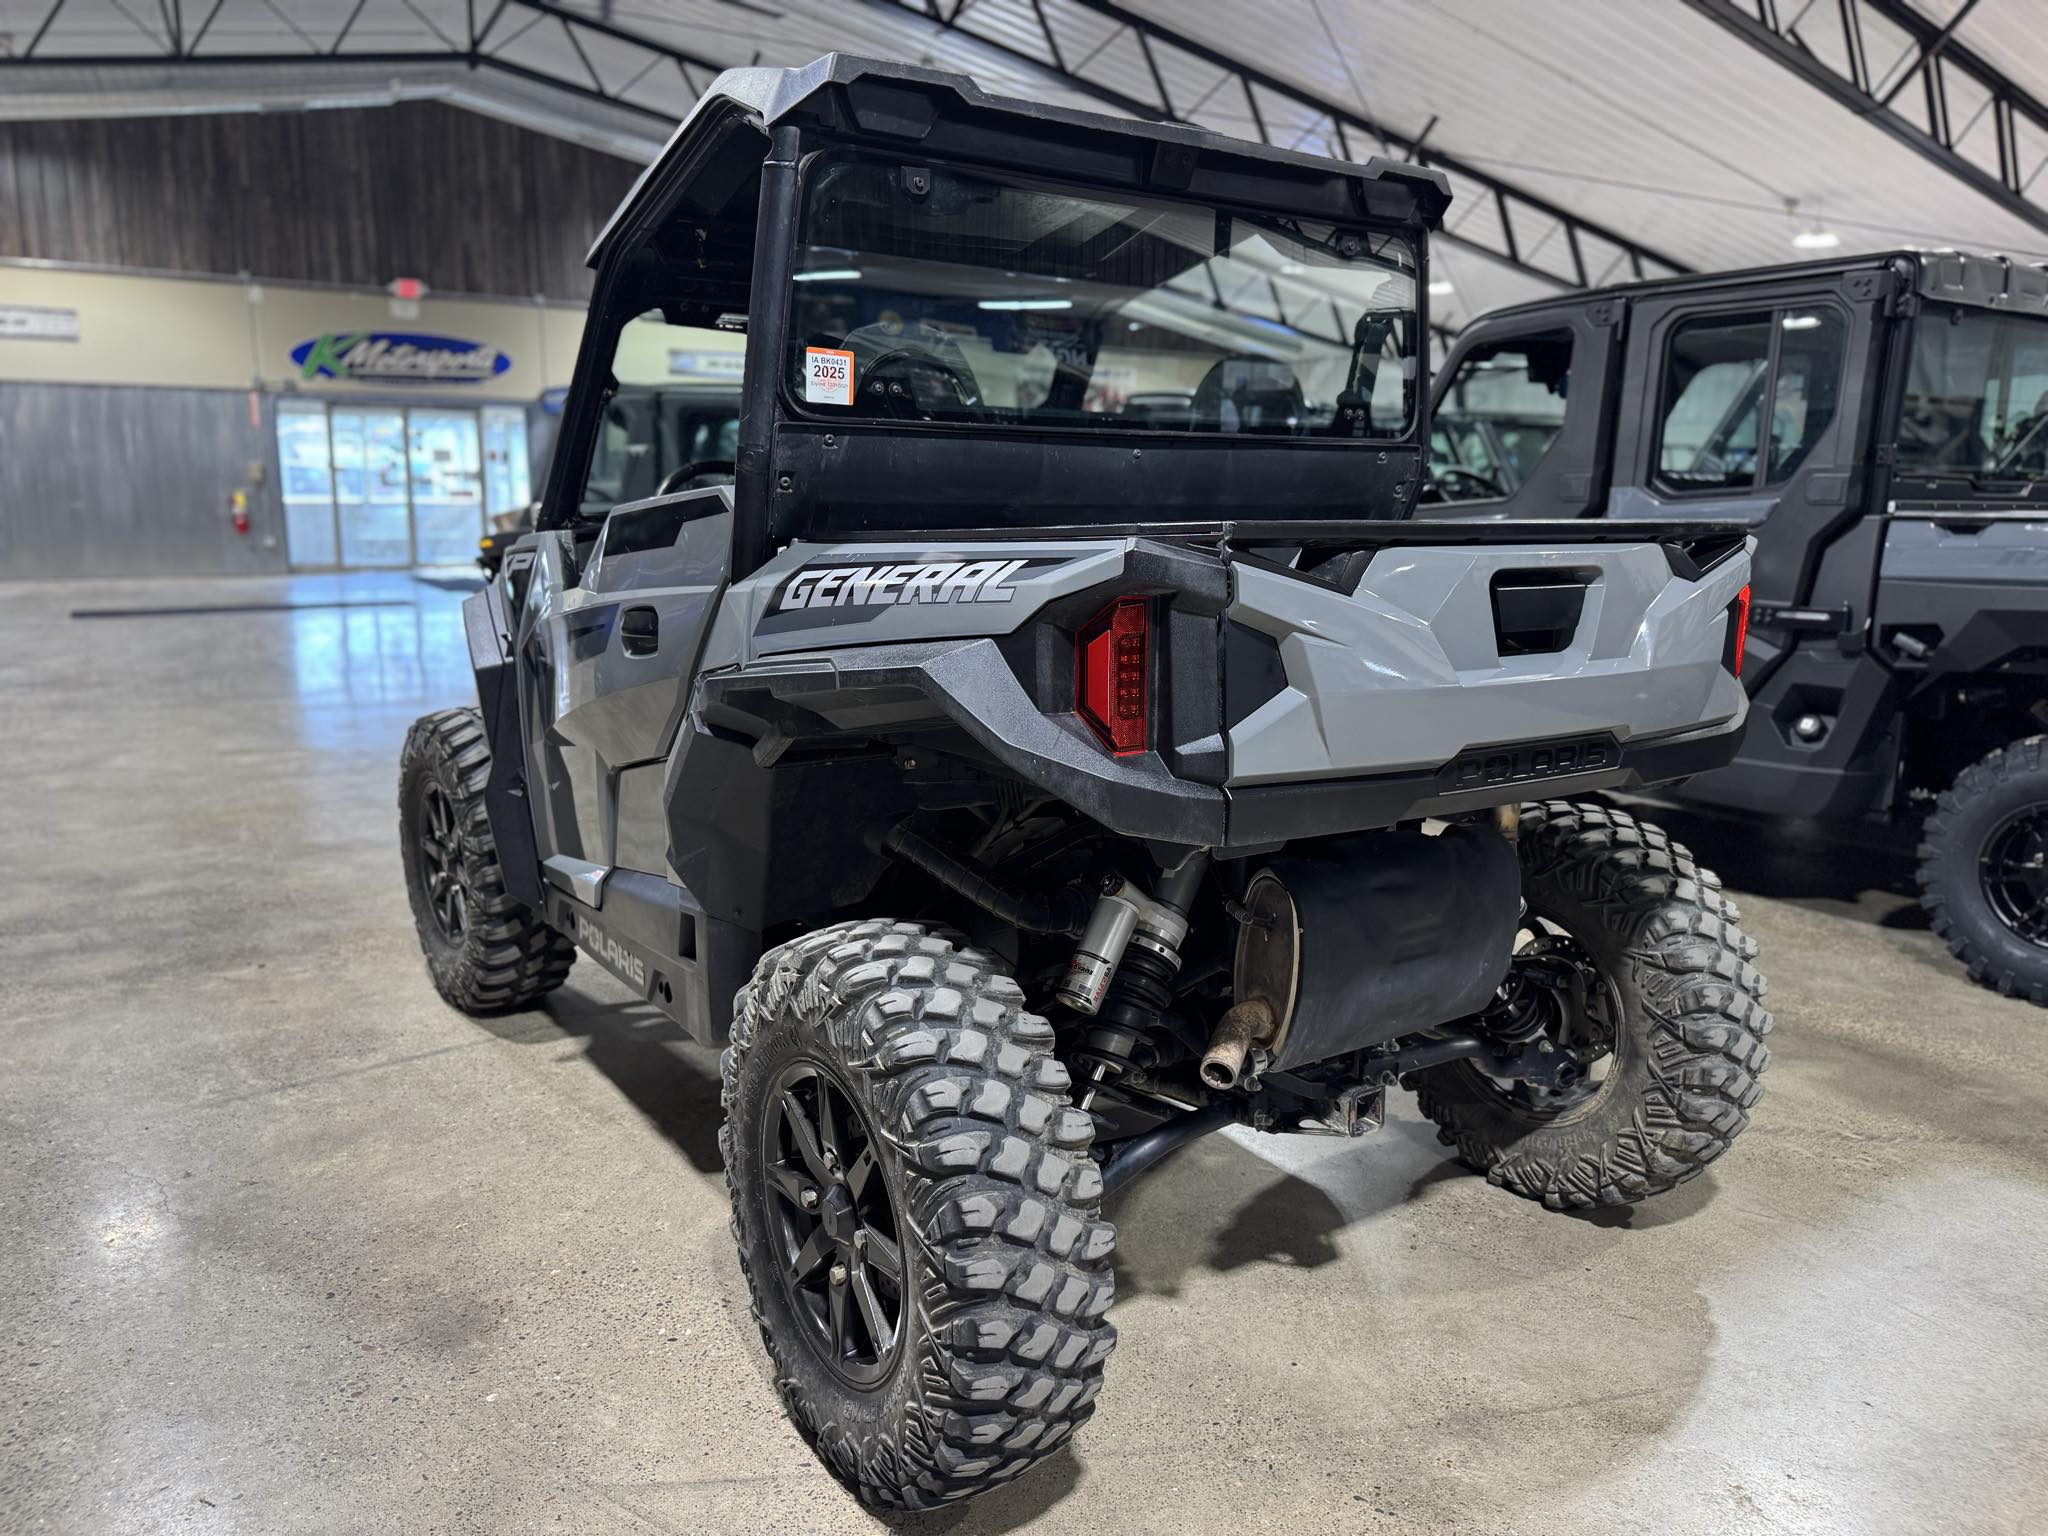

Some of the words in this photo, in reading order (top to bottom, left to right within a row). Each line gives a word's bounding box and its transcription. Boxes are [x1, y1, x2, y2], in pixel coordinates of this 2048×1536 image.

[813, 364, 845, 380] 2025
[778, 559, 1030, 611] GENERAL
[1454, 742, 1608, 787] POLARIS
[578, 914, 646, 989] POLARIS
